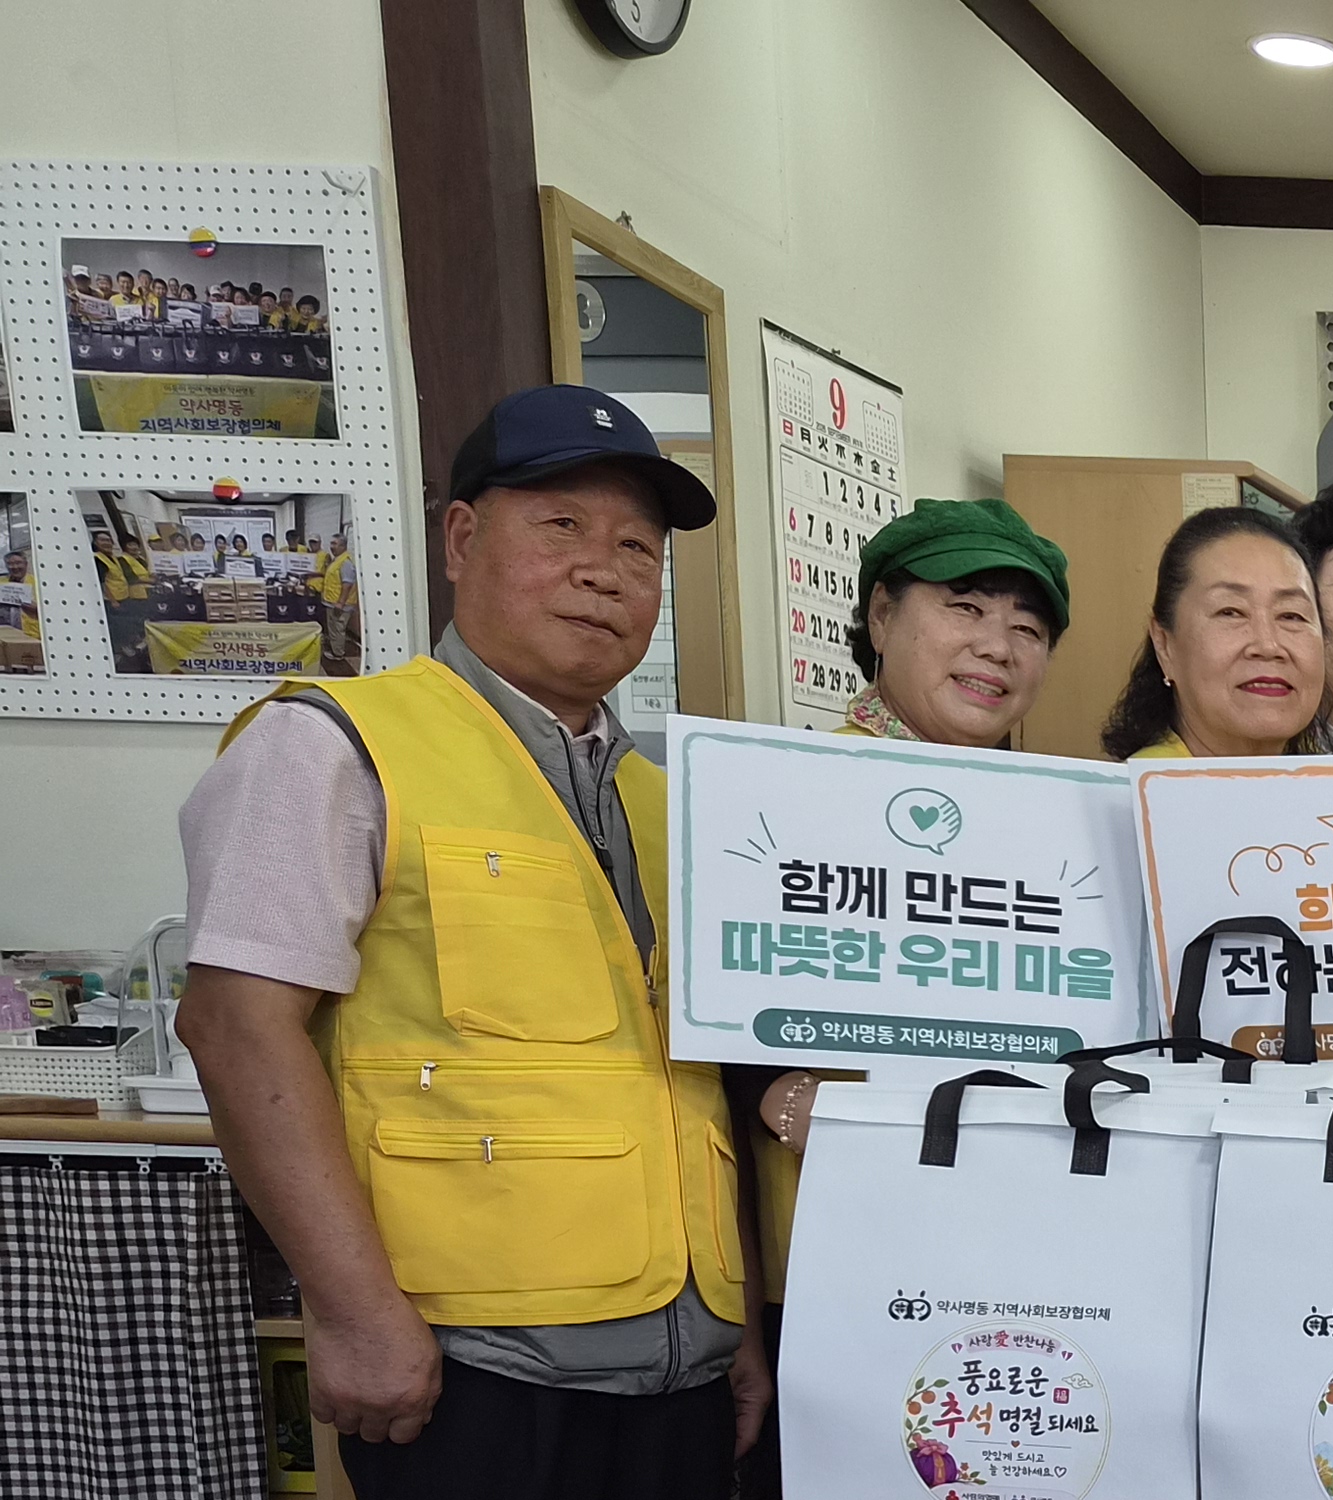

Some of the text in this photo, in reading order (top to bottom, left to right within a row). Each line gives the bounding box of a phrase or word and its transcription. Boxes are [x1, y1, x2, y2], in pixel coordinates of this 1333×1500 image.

[178, 398, 244, 417] 약사명동
[829, 377, 847, 431] 9
[139, 418, 282, 435] 지역사회보장협의체
[782, 418, 794, 437] 日
[800, 426, 812, 445] 月
[817, 435, 829, 453] 火
[853, 451, 864, 467] 木
[870, 458, 881, 476] 金
[887, 466, 897, 483] 土
[823, 470, 881, 517] 1 2 3 4
[789, 507, 815, 539] 6 7
[789, 557, 854, 601] 13 16
[791, 607, 840, 645] 20 22
[178, 658, 303, 673] 지역사회보장협의체
[212, 641, 269, 658] 약사명동
[793, 658, 857, 696] 27 30
[778, 858, 1063, 935] 함께 만드는
[721, 920, 1115, 1001] 따뜻한 우리 마을
[821, 1020, 1059, 1056] 약사명동 지역사회보장협의체
[936, 1299, 1112, 1322] 약사명동 지역사회보장협의체
[968, 1329, 1057, 1354] 사랑愛 반찬나눔
[957, 1360, 1050, 1398] 풍요로운
[932, 1391, 1100, 1438] 추석 명절 되세요
[981, 1450, 1046, 1463] 맛있게 드시고
[988, 1463, 1053, 1478] 늘 건강하세요
